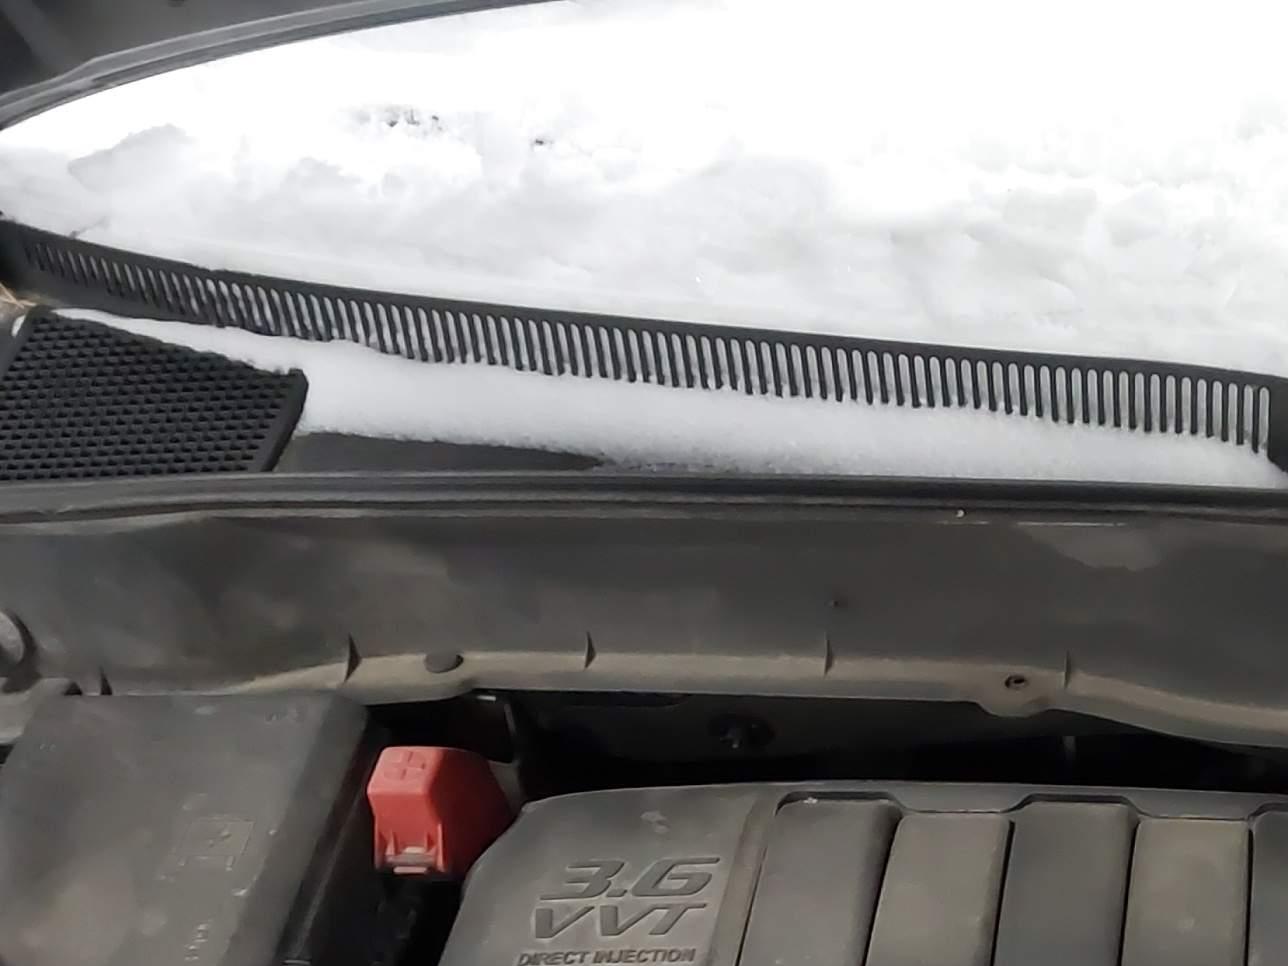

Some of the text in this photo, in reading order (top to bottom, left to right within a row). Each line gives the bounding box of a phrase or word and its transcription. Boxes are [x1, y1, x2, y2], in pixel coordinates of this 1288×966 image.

[540, 857, 721, 901] 3.6
[535, 903, 708, 939] VVT
[515, 948, 697, 966] DIRECT INJECTION
